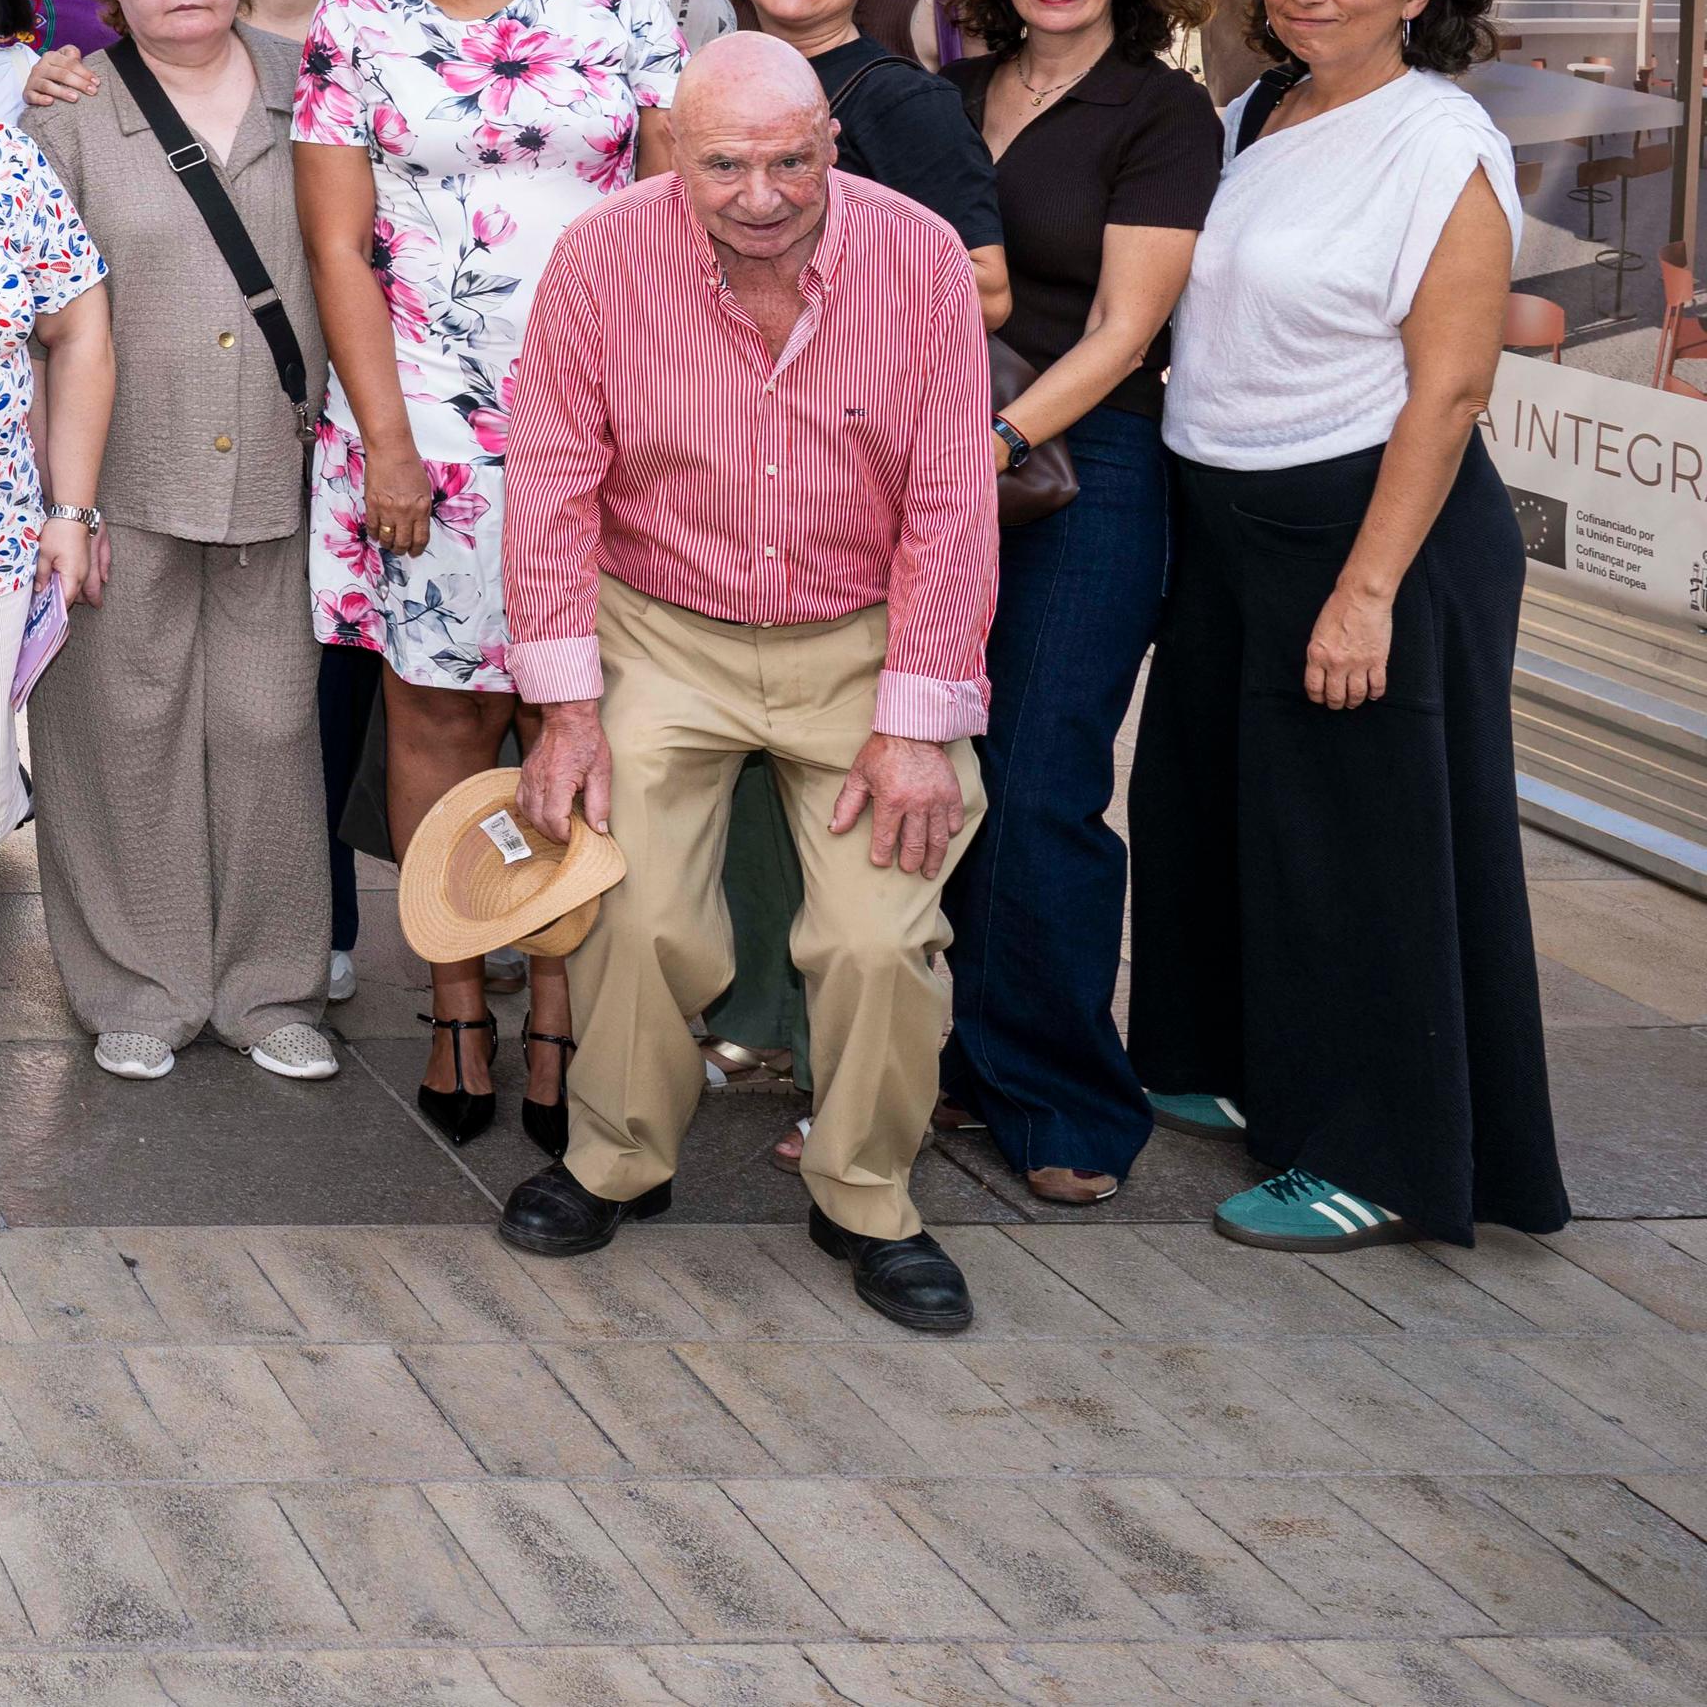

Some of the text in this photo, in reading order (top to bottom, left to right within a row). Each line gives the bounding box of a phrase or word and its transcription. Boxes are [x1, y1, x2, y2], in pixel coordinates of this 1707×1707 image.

[1515, 399, 1707, 503] INTEGR
[1576, 509, 1655, 542] Cofinanciado por
[1576, 524, 1654, 559] la Unión Europea
[1576, 543, 1641, 575] Cofinançat per
[1576, 558, 1647, 592] la Unió Europea
